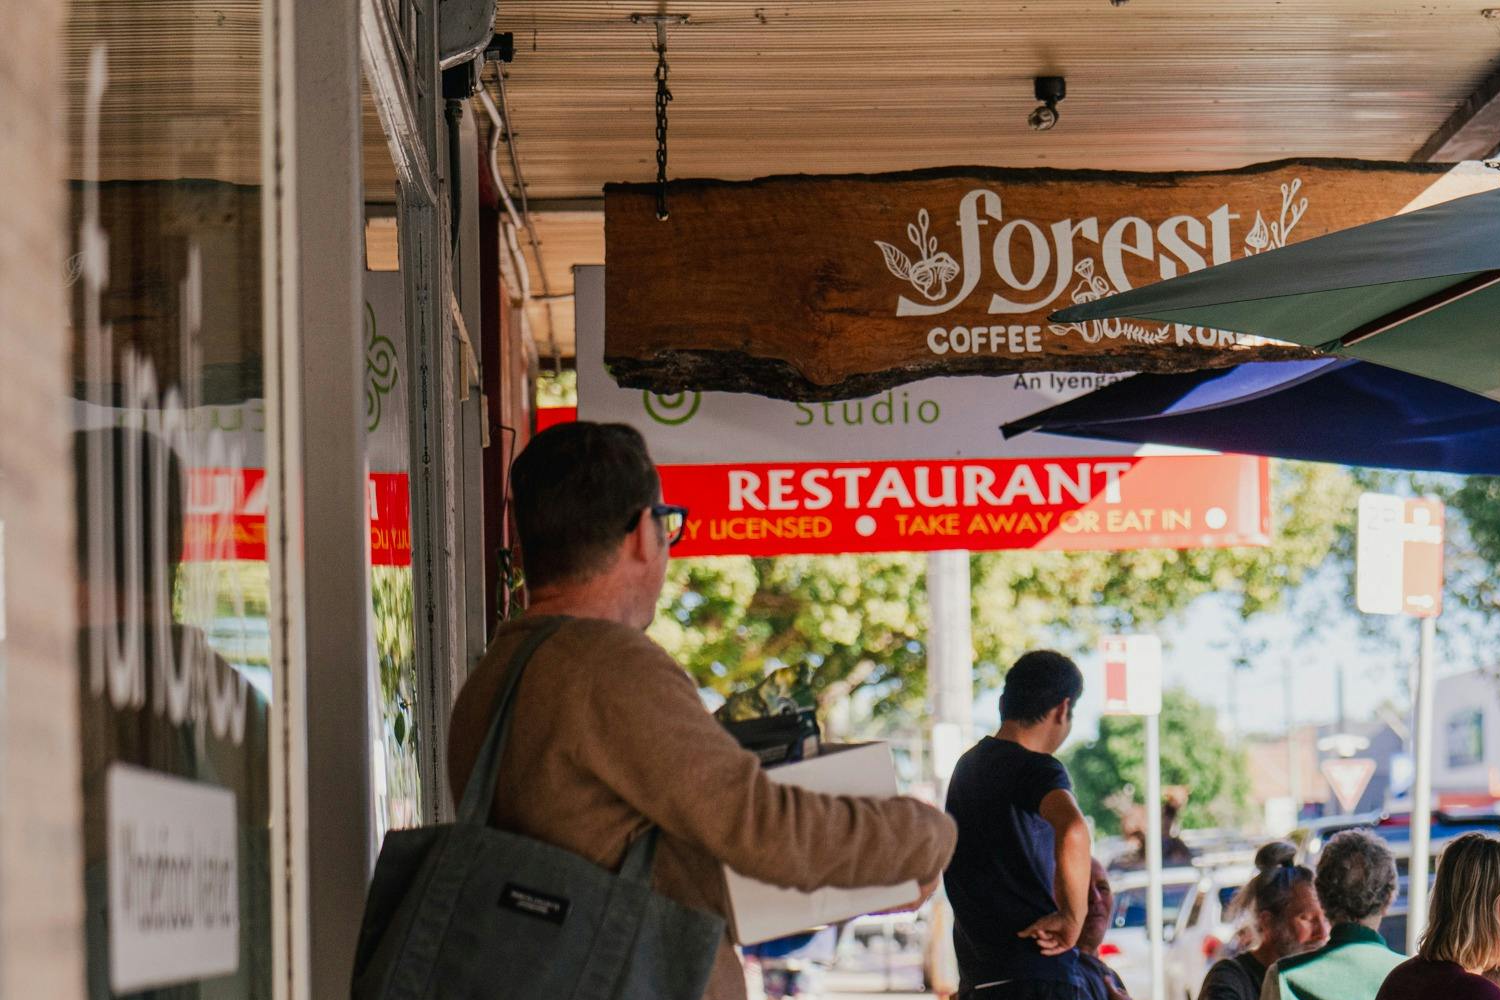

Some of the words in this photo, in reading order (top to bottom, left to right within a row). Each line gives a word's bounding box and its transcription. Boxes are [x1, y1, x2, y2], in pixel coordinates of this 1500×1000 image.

[895, 189, 1240, 316] forest
[927, 325, 1042, 354] COFFEE
[1014, 373, 1041, 390] An
[1051, 374, 1121, 392] Iyenga
[796, 392, 940, 426] Studio
[728, 462, 1131, 511] RESTAURANT
[710, 515, 832, 540] LICENSED
[895, 513, 980, 536] TAKE
[987, 511, 1055, 535] AWAY
[1060, 510, 1101, 533] OR
[1106, 509, 1158, 532] EAT
[1162, 508, 1191, 530] IN
